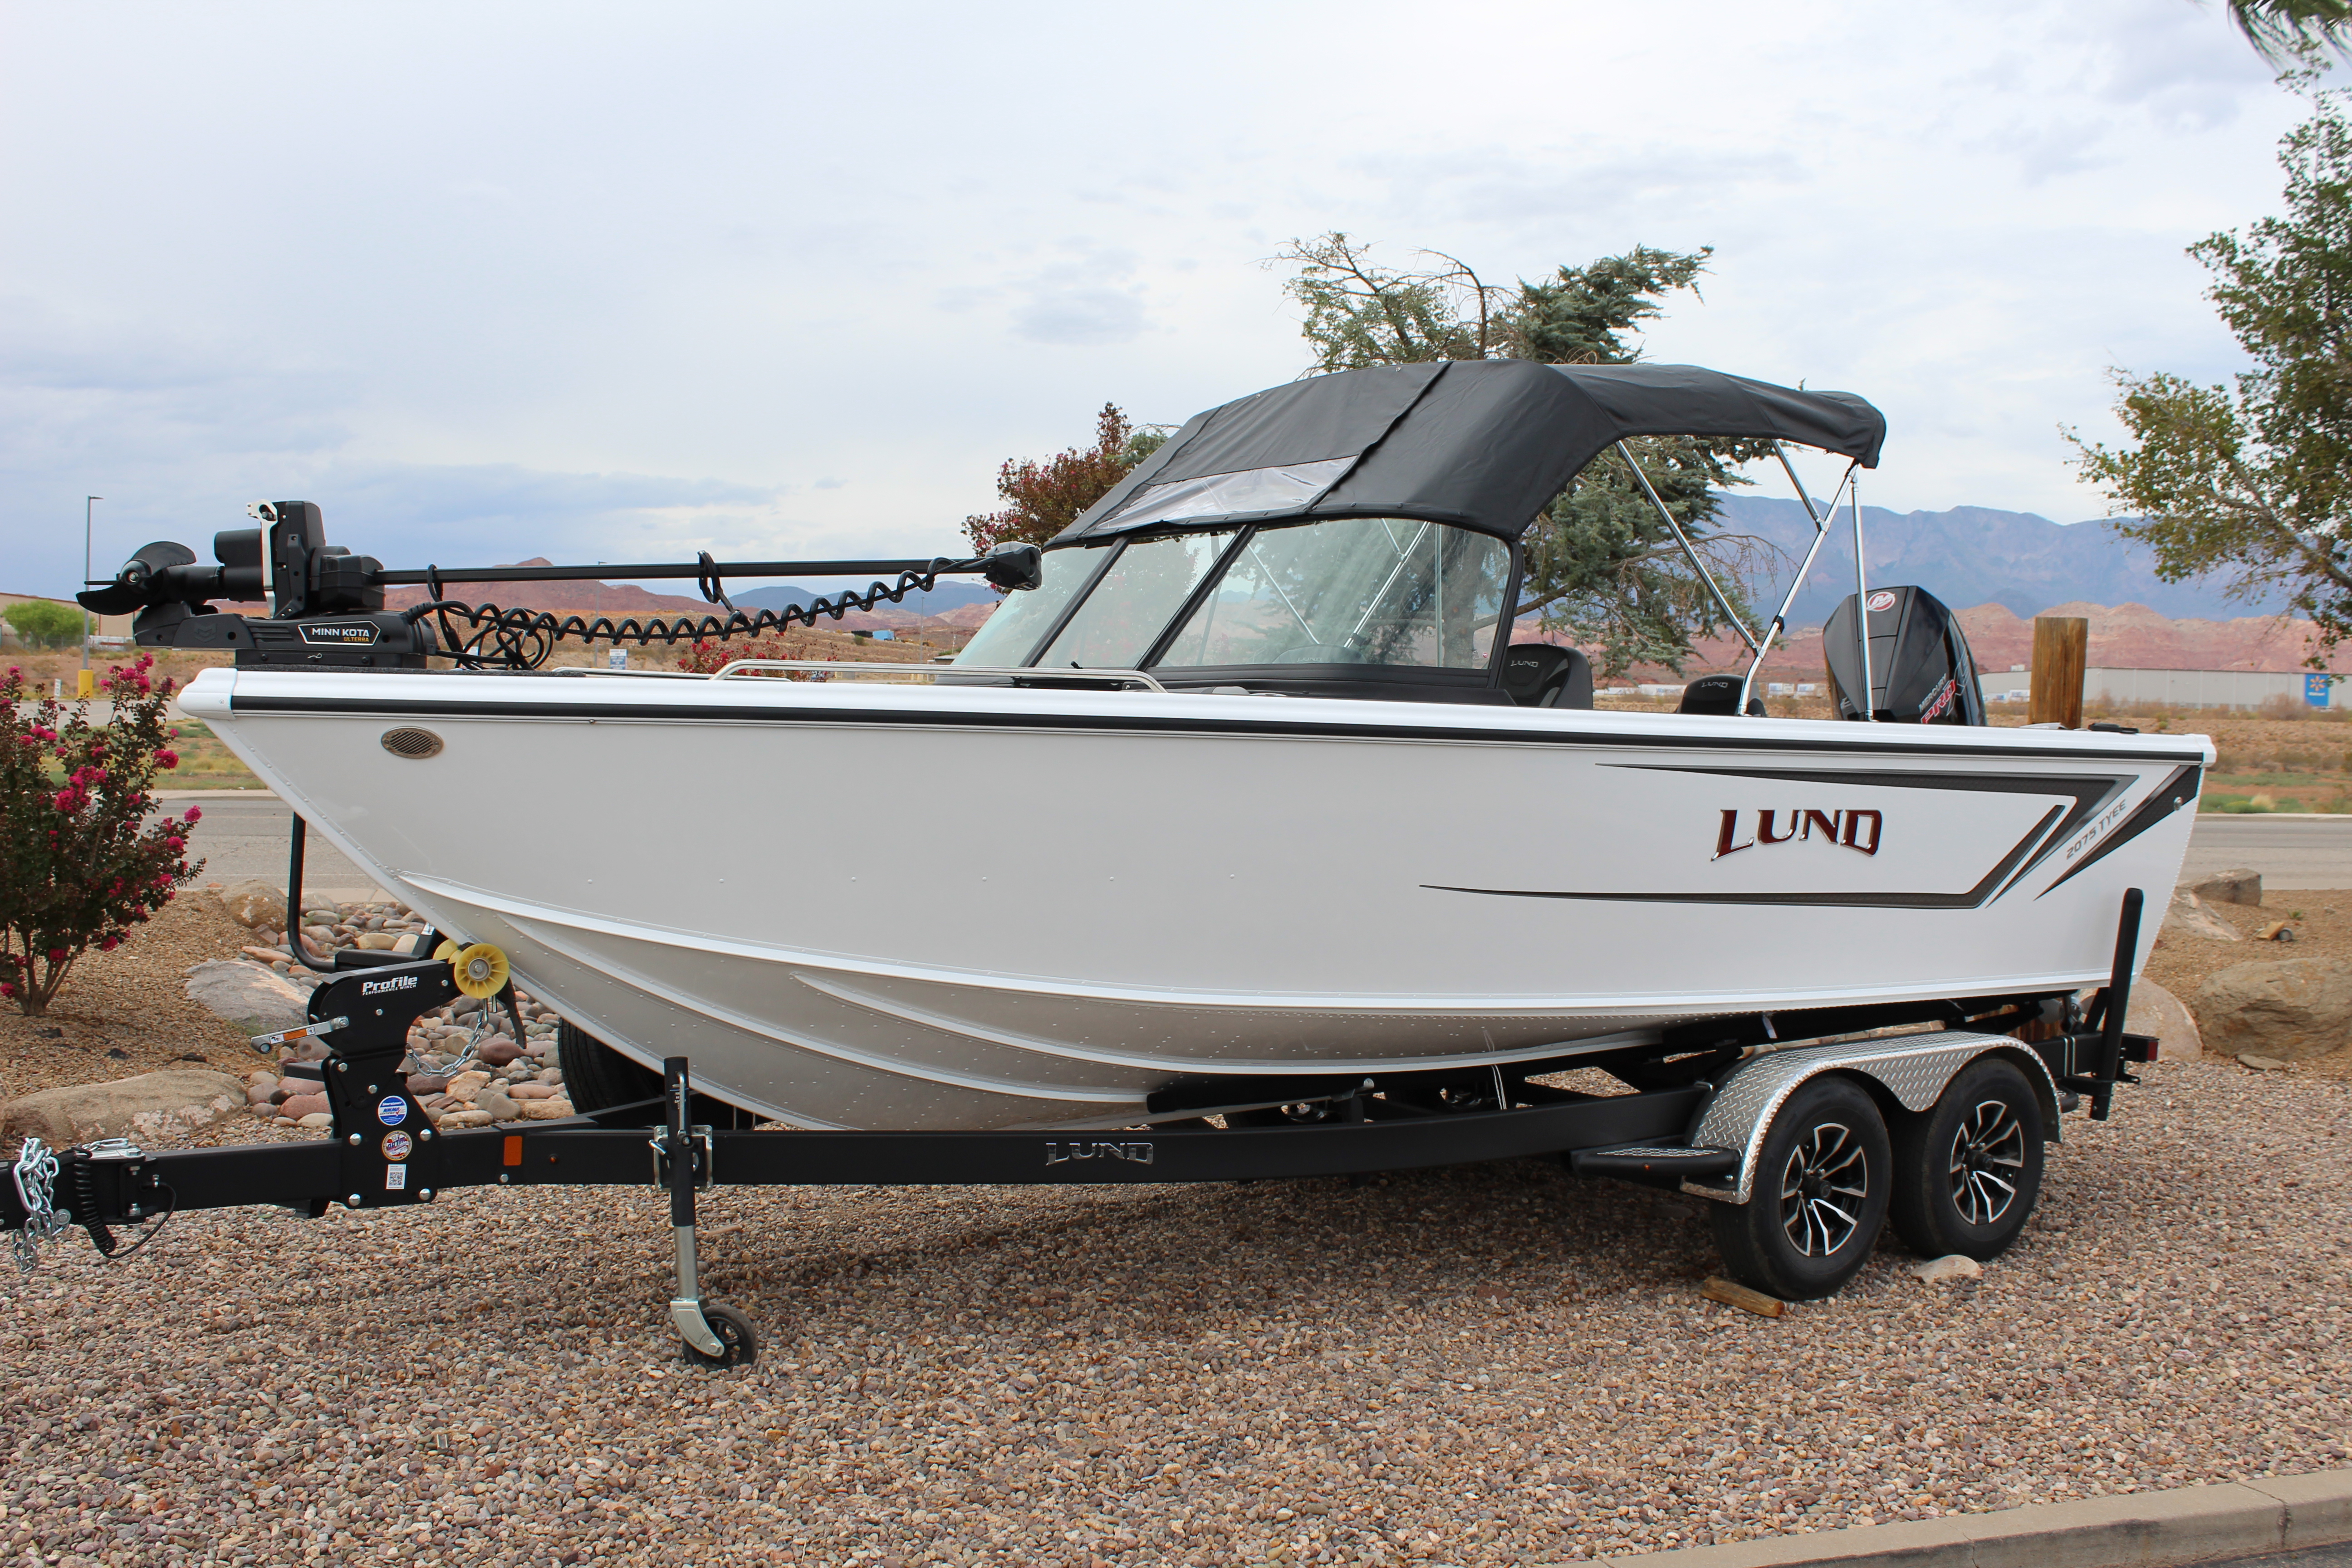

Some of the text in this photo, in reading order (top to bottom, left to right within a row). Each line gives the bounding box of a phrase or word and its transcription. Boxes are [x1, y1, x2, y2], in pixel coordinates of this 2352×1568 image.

[342, 629, 370, 637] KOTA
[1510, 660, 1539, 668] LUND
[1918, 673, 1946, 713] MERCURY
[1921, 679, 1956, 724] PRO
[1710, 809, 1882, 862] LUND
[2066, 799, 2127, 860] 2075 TYEE
[362, 975, 418, 992] Profile
[363, 987, 398, 995] PERFORMANCE
[1046, 1142, 1153, 1166] LUND
